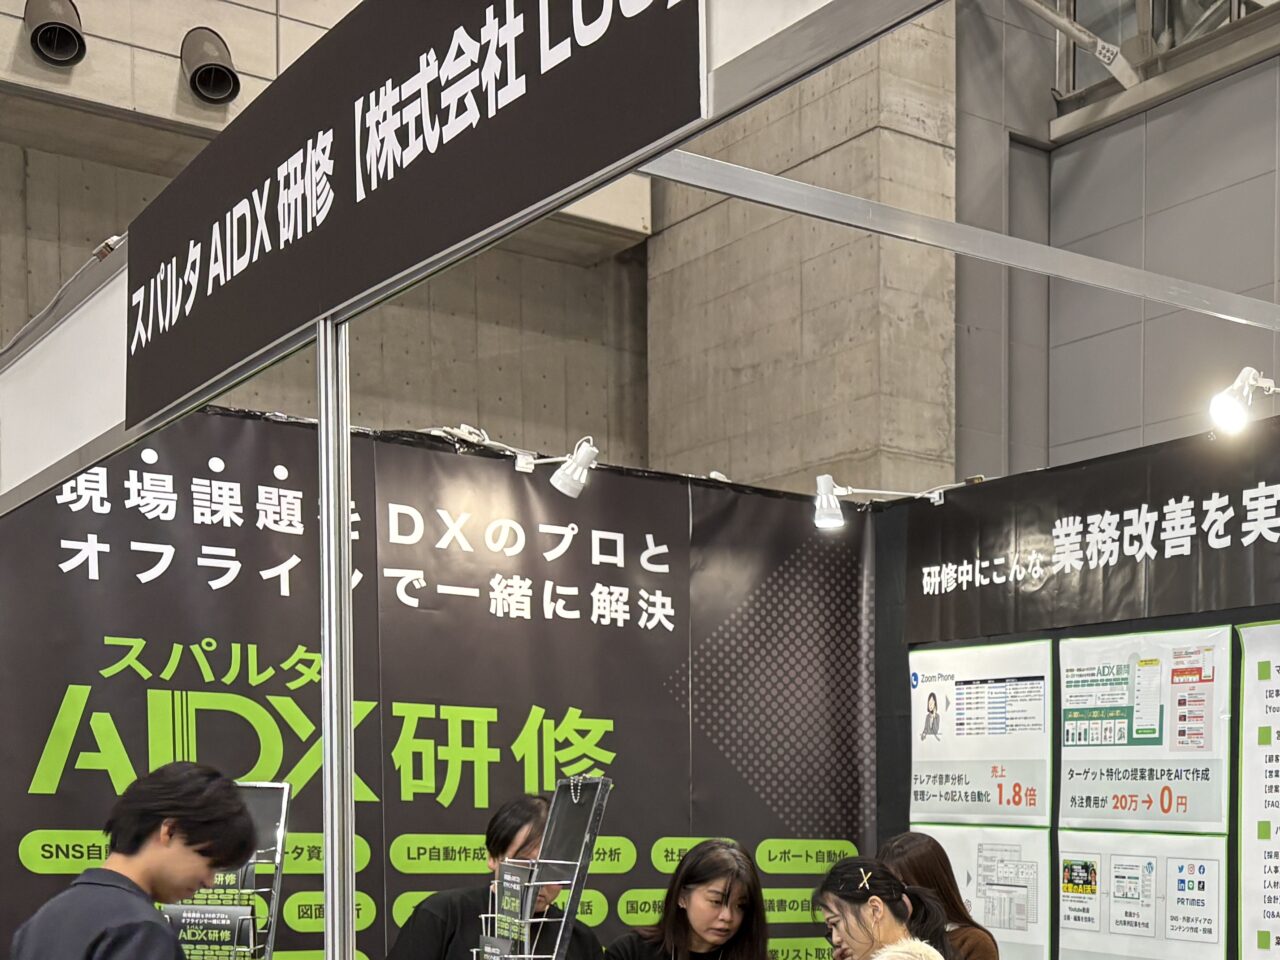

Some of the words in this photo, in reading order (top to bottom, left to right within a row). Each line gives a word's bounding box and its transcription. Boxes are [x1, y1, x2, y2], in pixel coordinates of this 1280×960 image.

[130, 240, 201, 356] スパルタ
[207, 178, 272, 296] AIDX
[277, 129, 335, 249] 研修
[538, 0, 687, 75] LO
[99, 635, 322, 691] スパルタ
[991, 765, 1006, 779] 売上
[1067, 768, 1211, 784] ターゲット特化の提案書LPをAIで作成
[913, 788, 991, 804] 管理シートの記入を自動化
[1070, 794, 1108, 810] 外注費用が
[40, 843, 110, 860] SNS自
